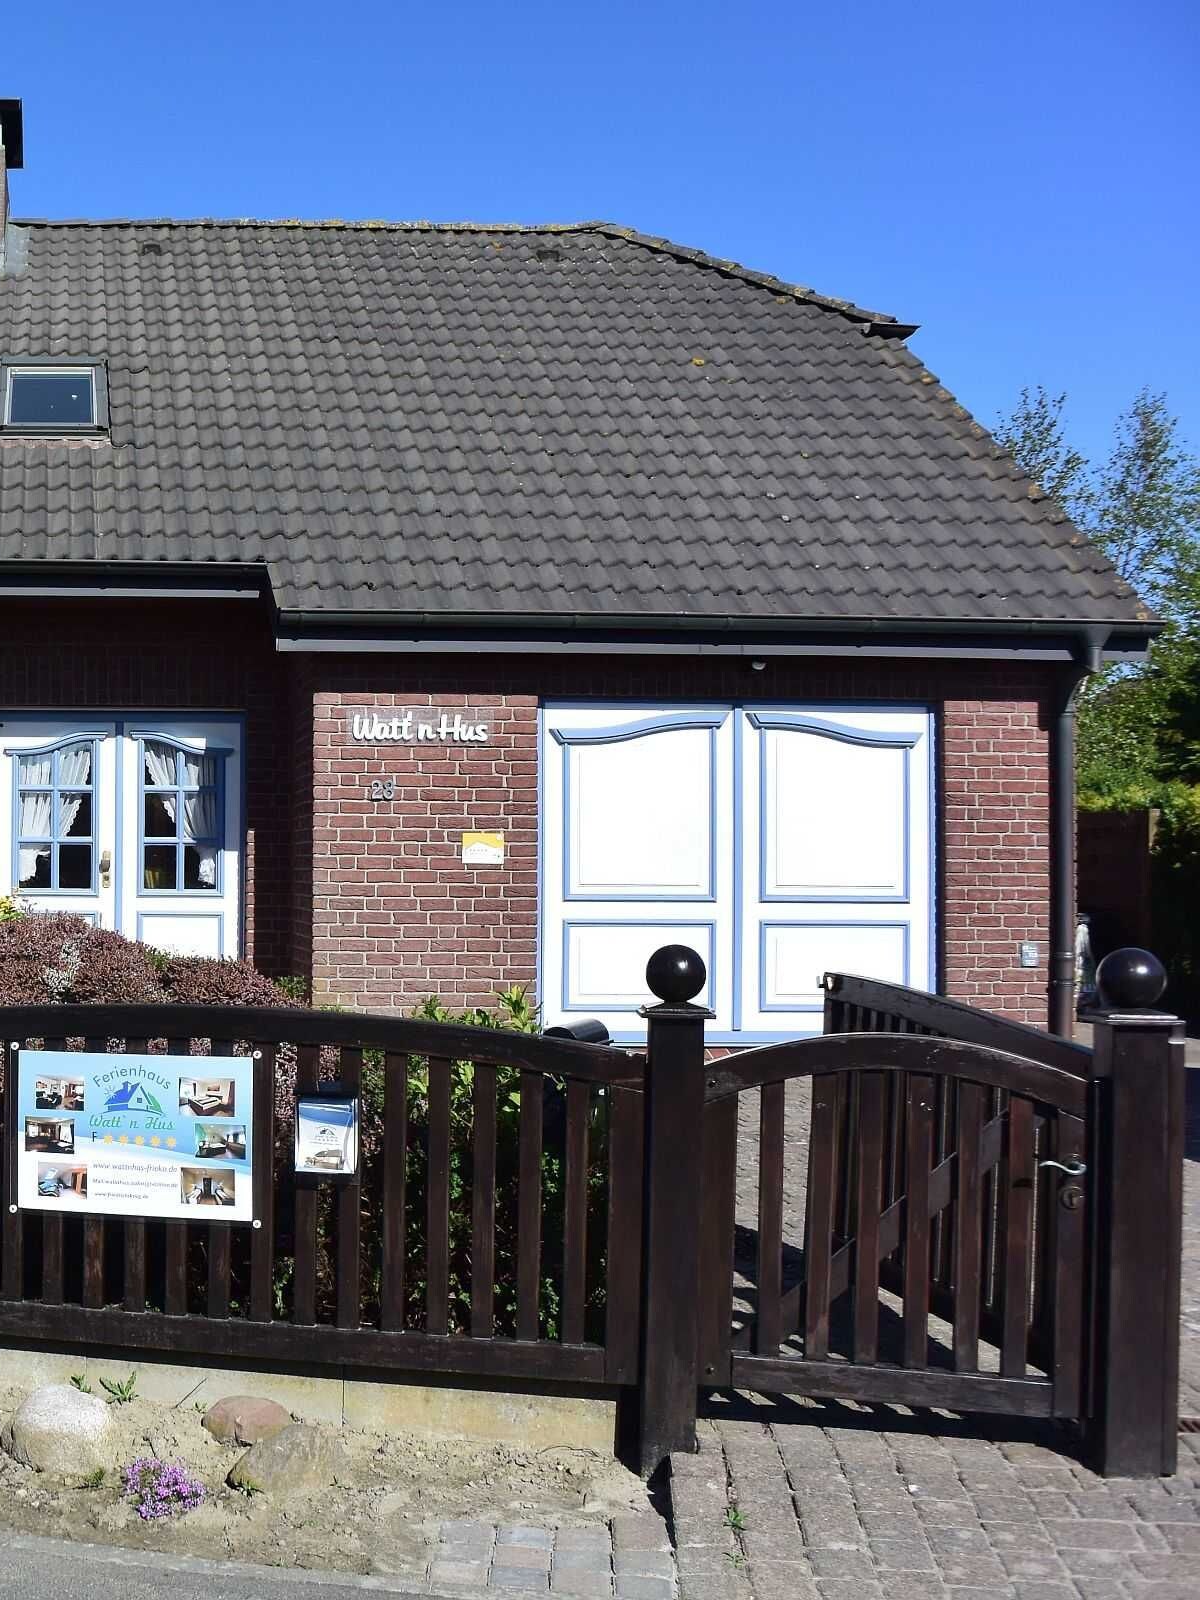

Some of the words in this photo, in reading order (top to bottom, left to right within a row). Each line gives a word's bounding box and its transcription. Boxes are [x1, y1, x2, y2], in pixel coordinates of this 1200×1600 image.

[417, 723, 437, 741] n
[437, 714, 489, 742] Hus
[93, 1065, 171, 1089] Ferienhaus
[129, 1118, 140, 1129] n
[144, 1116, 176, 1130] Hus
[92, 1131, 98, 1142] F
